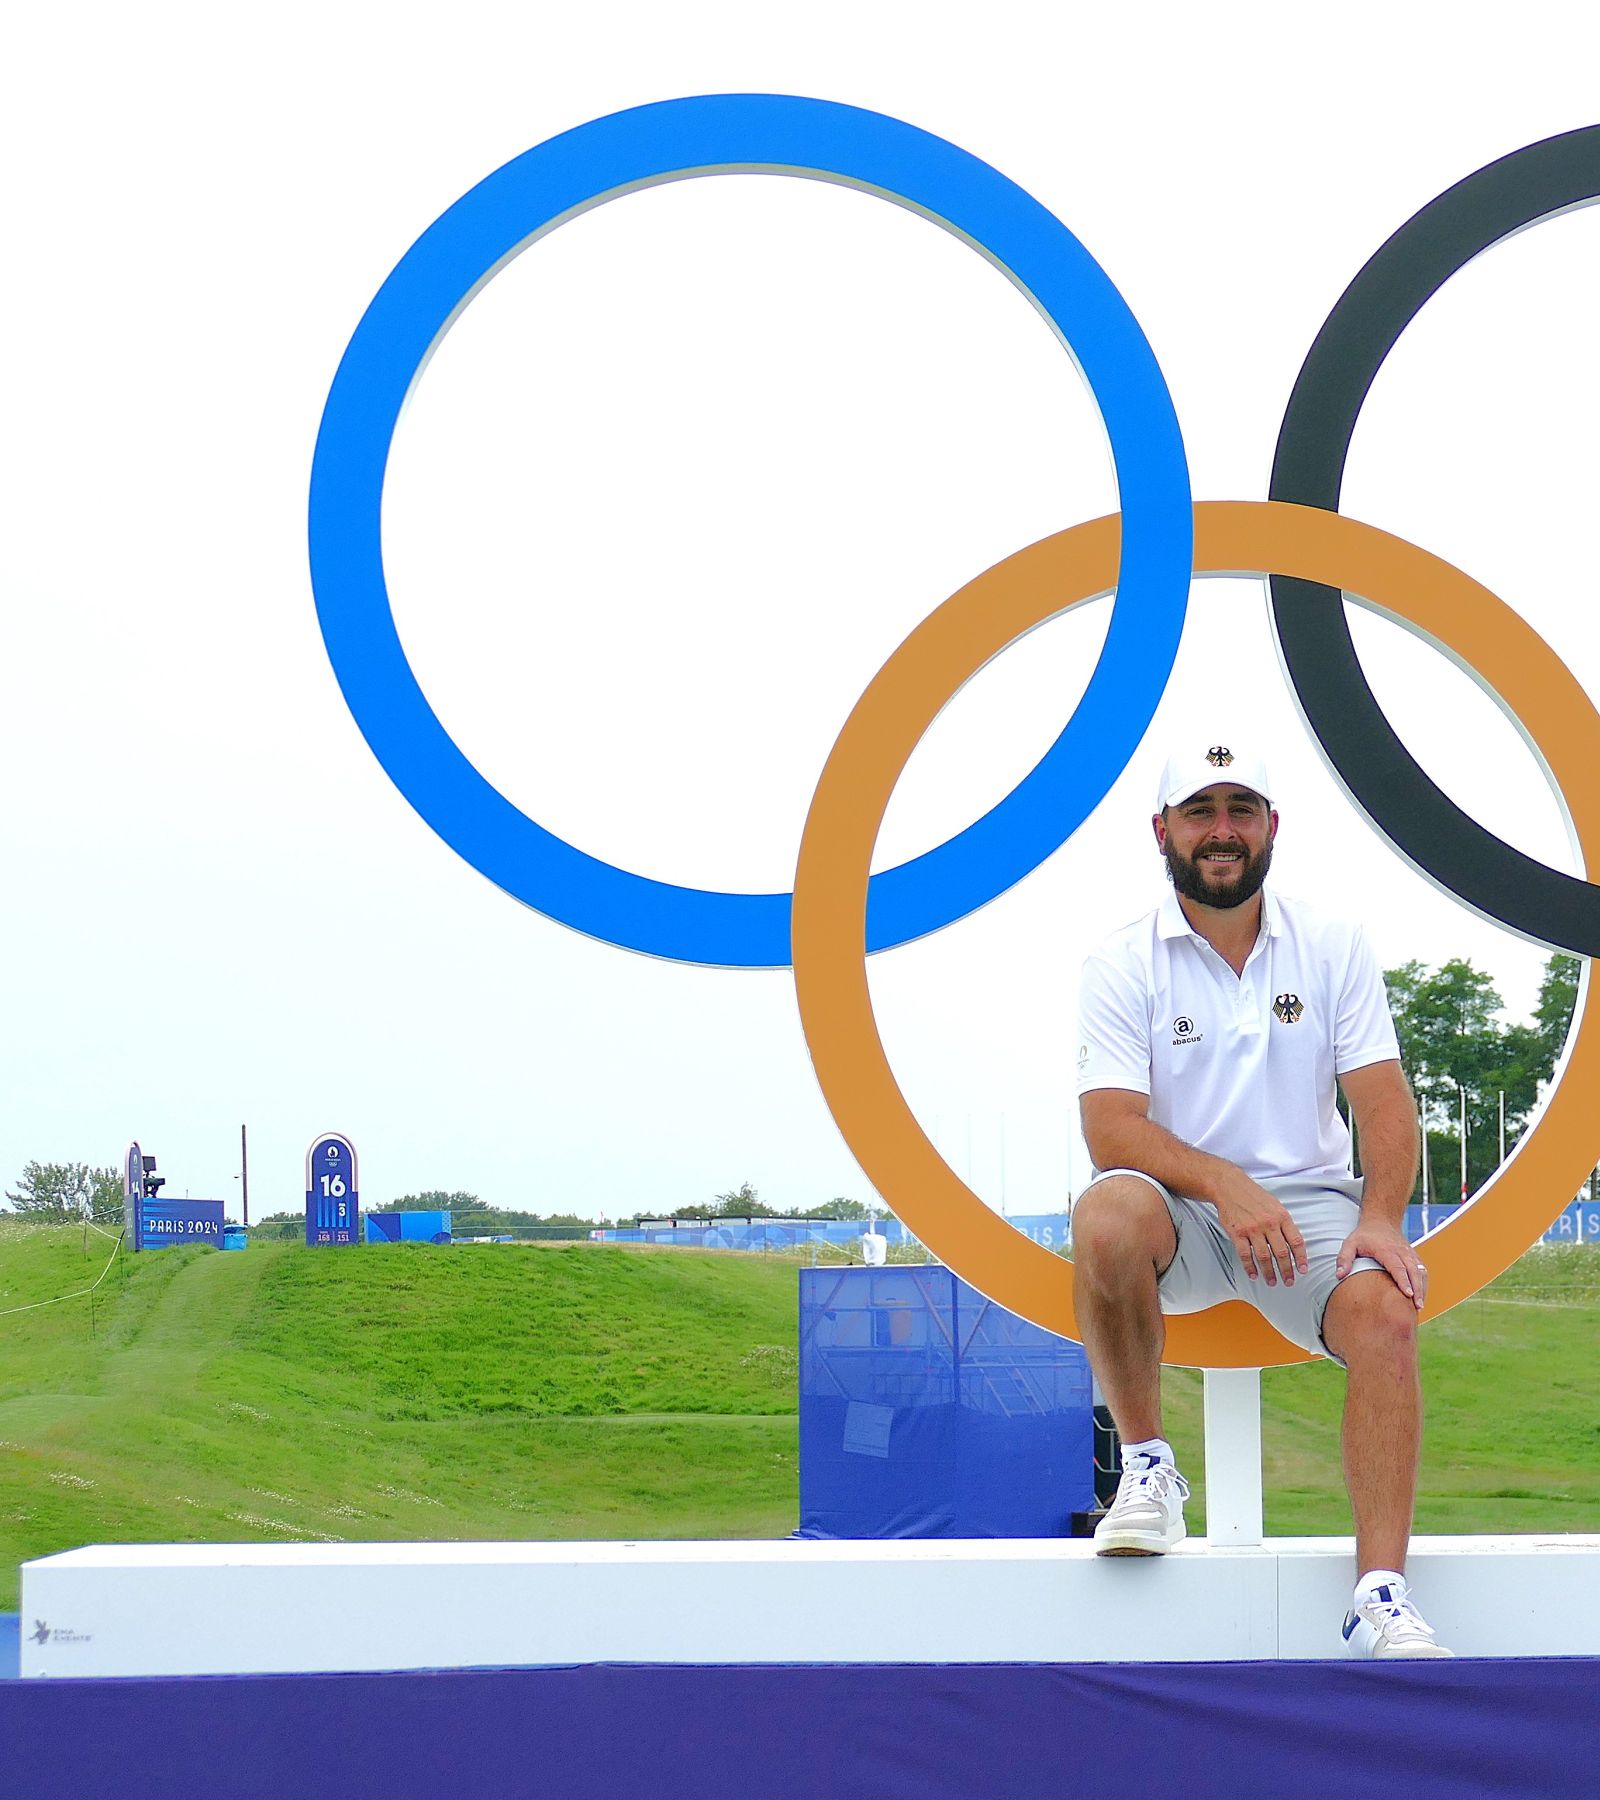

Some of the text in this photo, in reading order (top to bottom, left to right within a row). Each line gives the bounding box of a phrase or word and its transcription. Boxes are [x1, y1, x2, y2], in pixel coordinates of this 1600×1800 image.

[320, 1174, 346, 1197] 16
[338, 1206, 346, 1217] 3
[187, 1220, 218, 1234] 2024
[337, 1234, 349, 1242] 151
